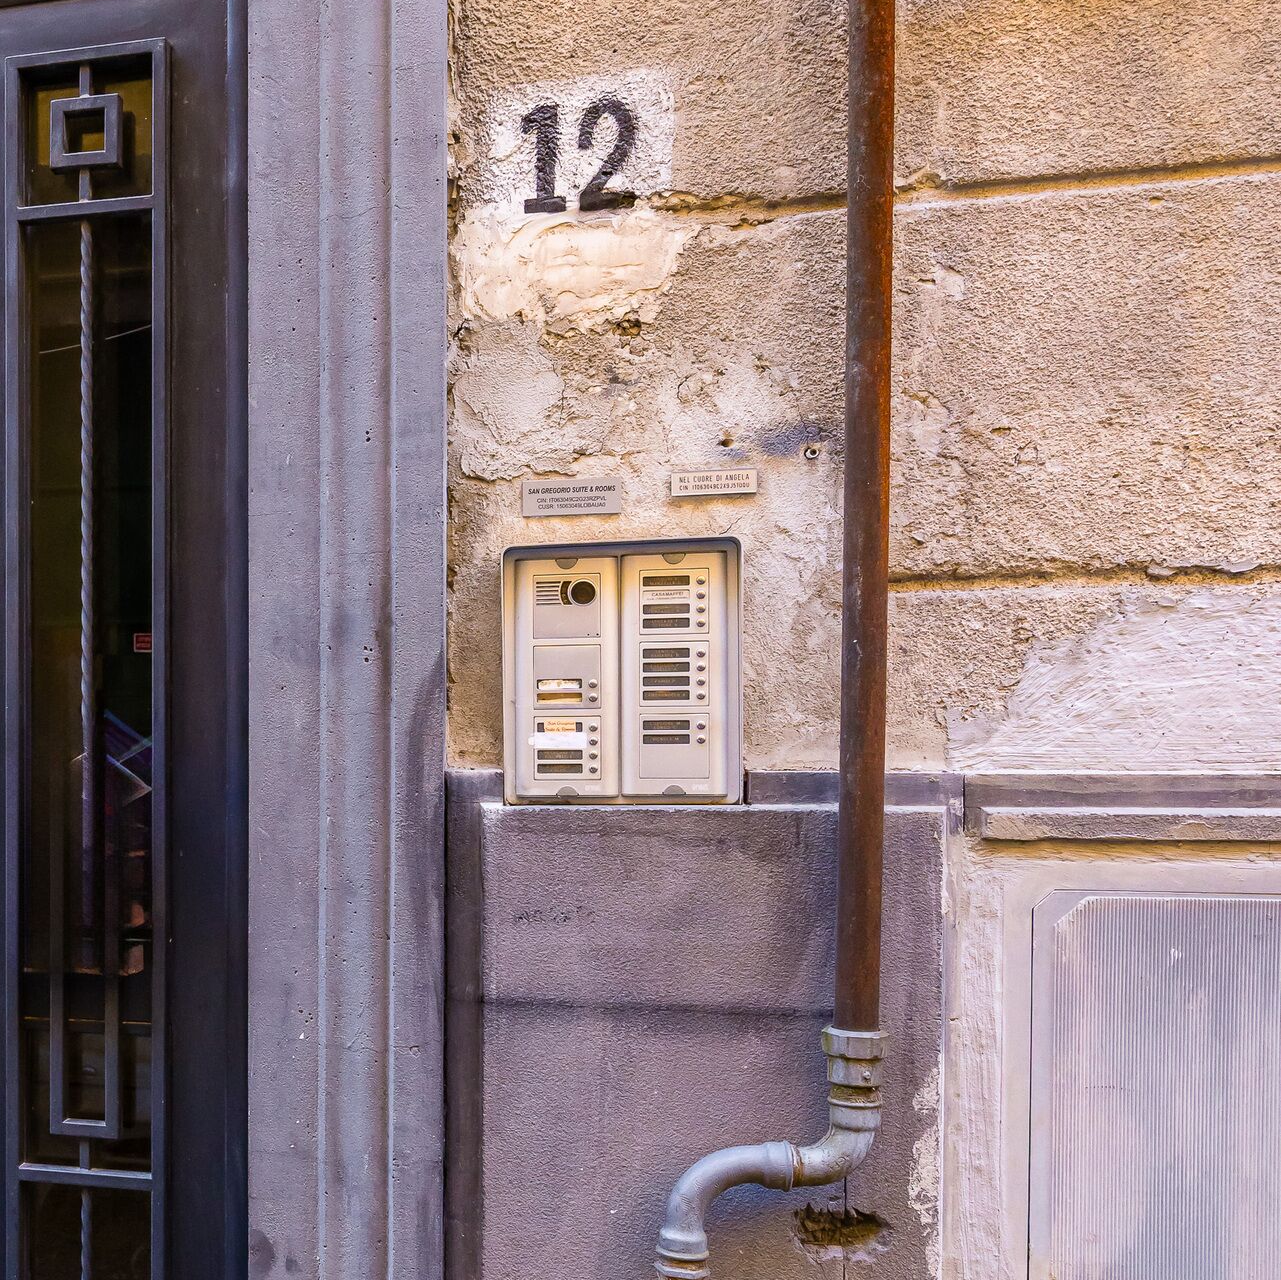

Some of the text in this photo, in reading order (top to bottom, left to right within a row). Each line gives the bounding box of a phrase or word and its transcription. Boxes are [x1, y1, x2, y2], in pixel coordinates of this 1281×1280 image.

[521, 96, 637, 213] 12
[693, 475, 712, 483] CUORE
[716, 474, 722, 482] DI
[725, 473, 750, 481] ANGELA
[540, 486, 570, 495] GREGORIO
[594, 484, 616, 493] ROOMS
